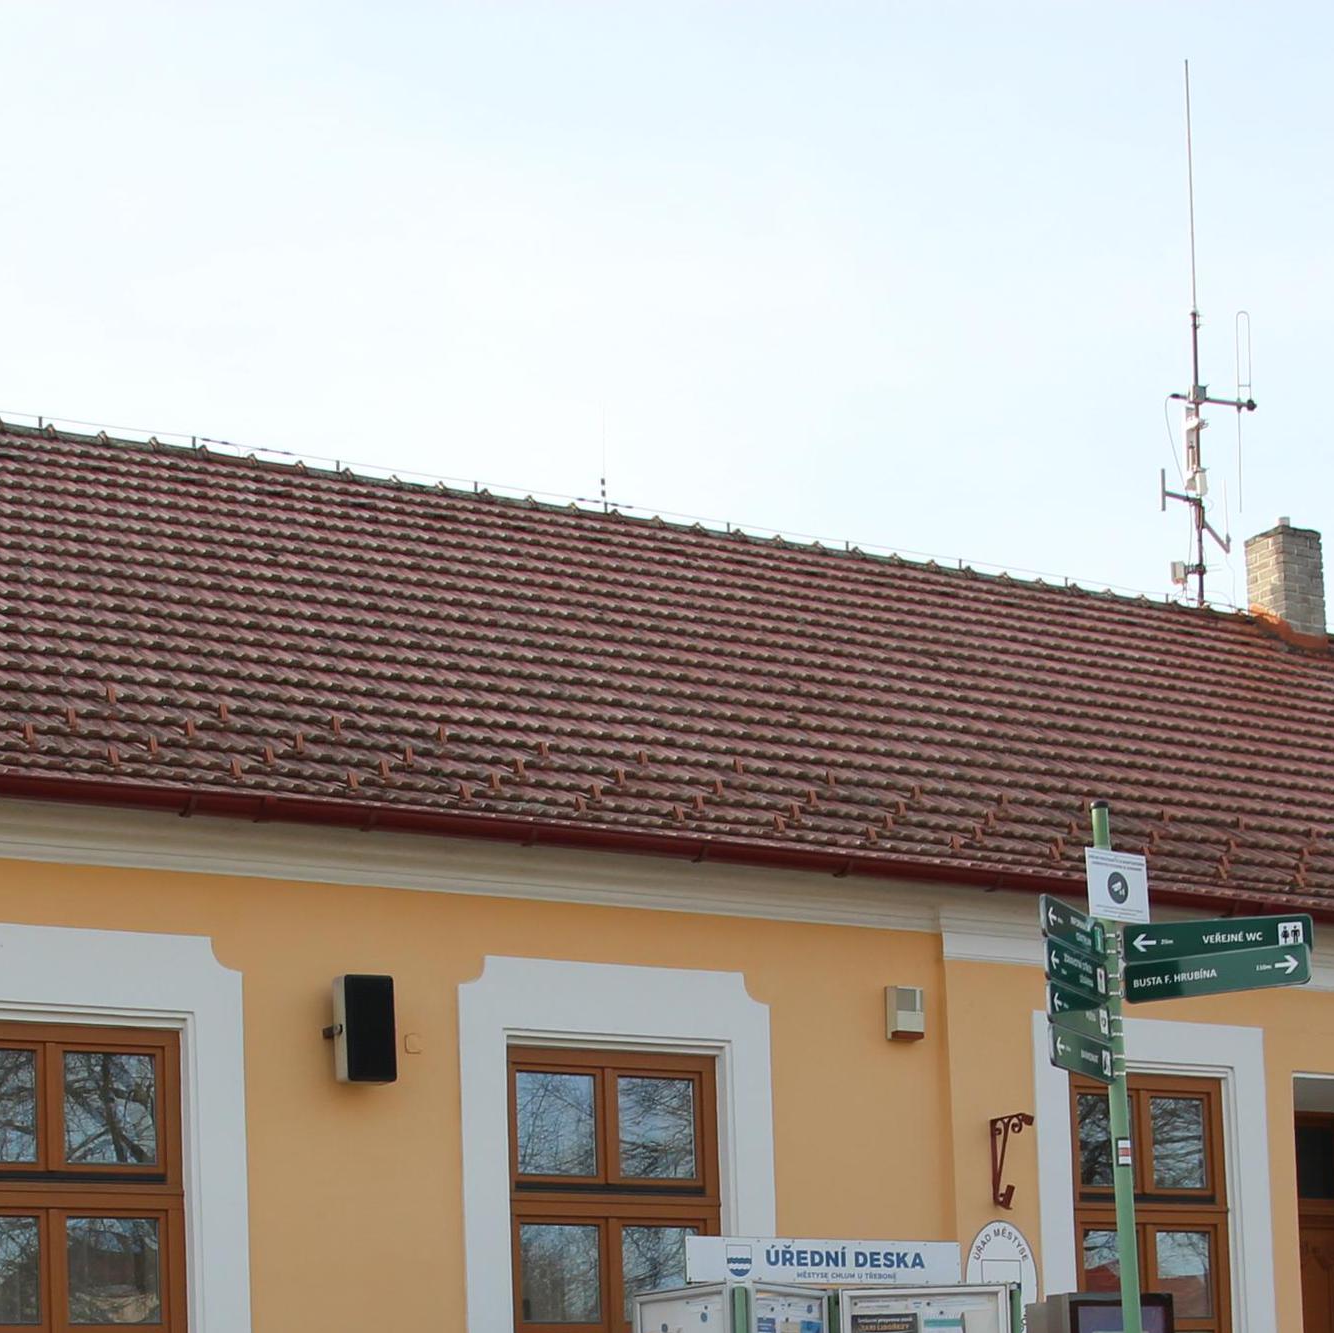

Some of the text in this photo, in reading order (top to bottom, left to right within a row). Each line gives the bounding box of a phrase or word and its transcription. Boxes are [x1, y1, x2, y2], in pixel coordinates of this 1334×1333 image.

[1202, 931, 1264, 944] VEŘEJNÉ WC
[1133, 974, 1163, 989] BUSTA
[1173, 968, 1217, 983] HRUBÍNA
[993, 1226, 1028, 1262] MĚSTYSE
[765, 1244, 925, 1270] ÚŘEDNÍ DESKA
[796, 1271, 828, 1279] MĚSTYSE
[865, 1271, 897, 1280] TŘEBONĚ
